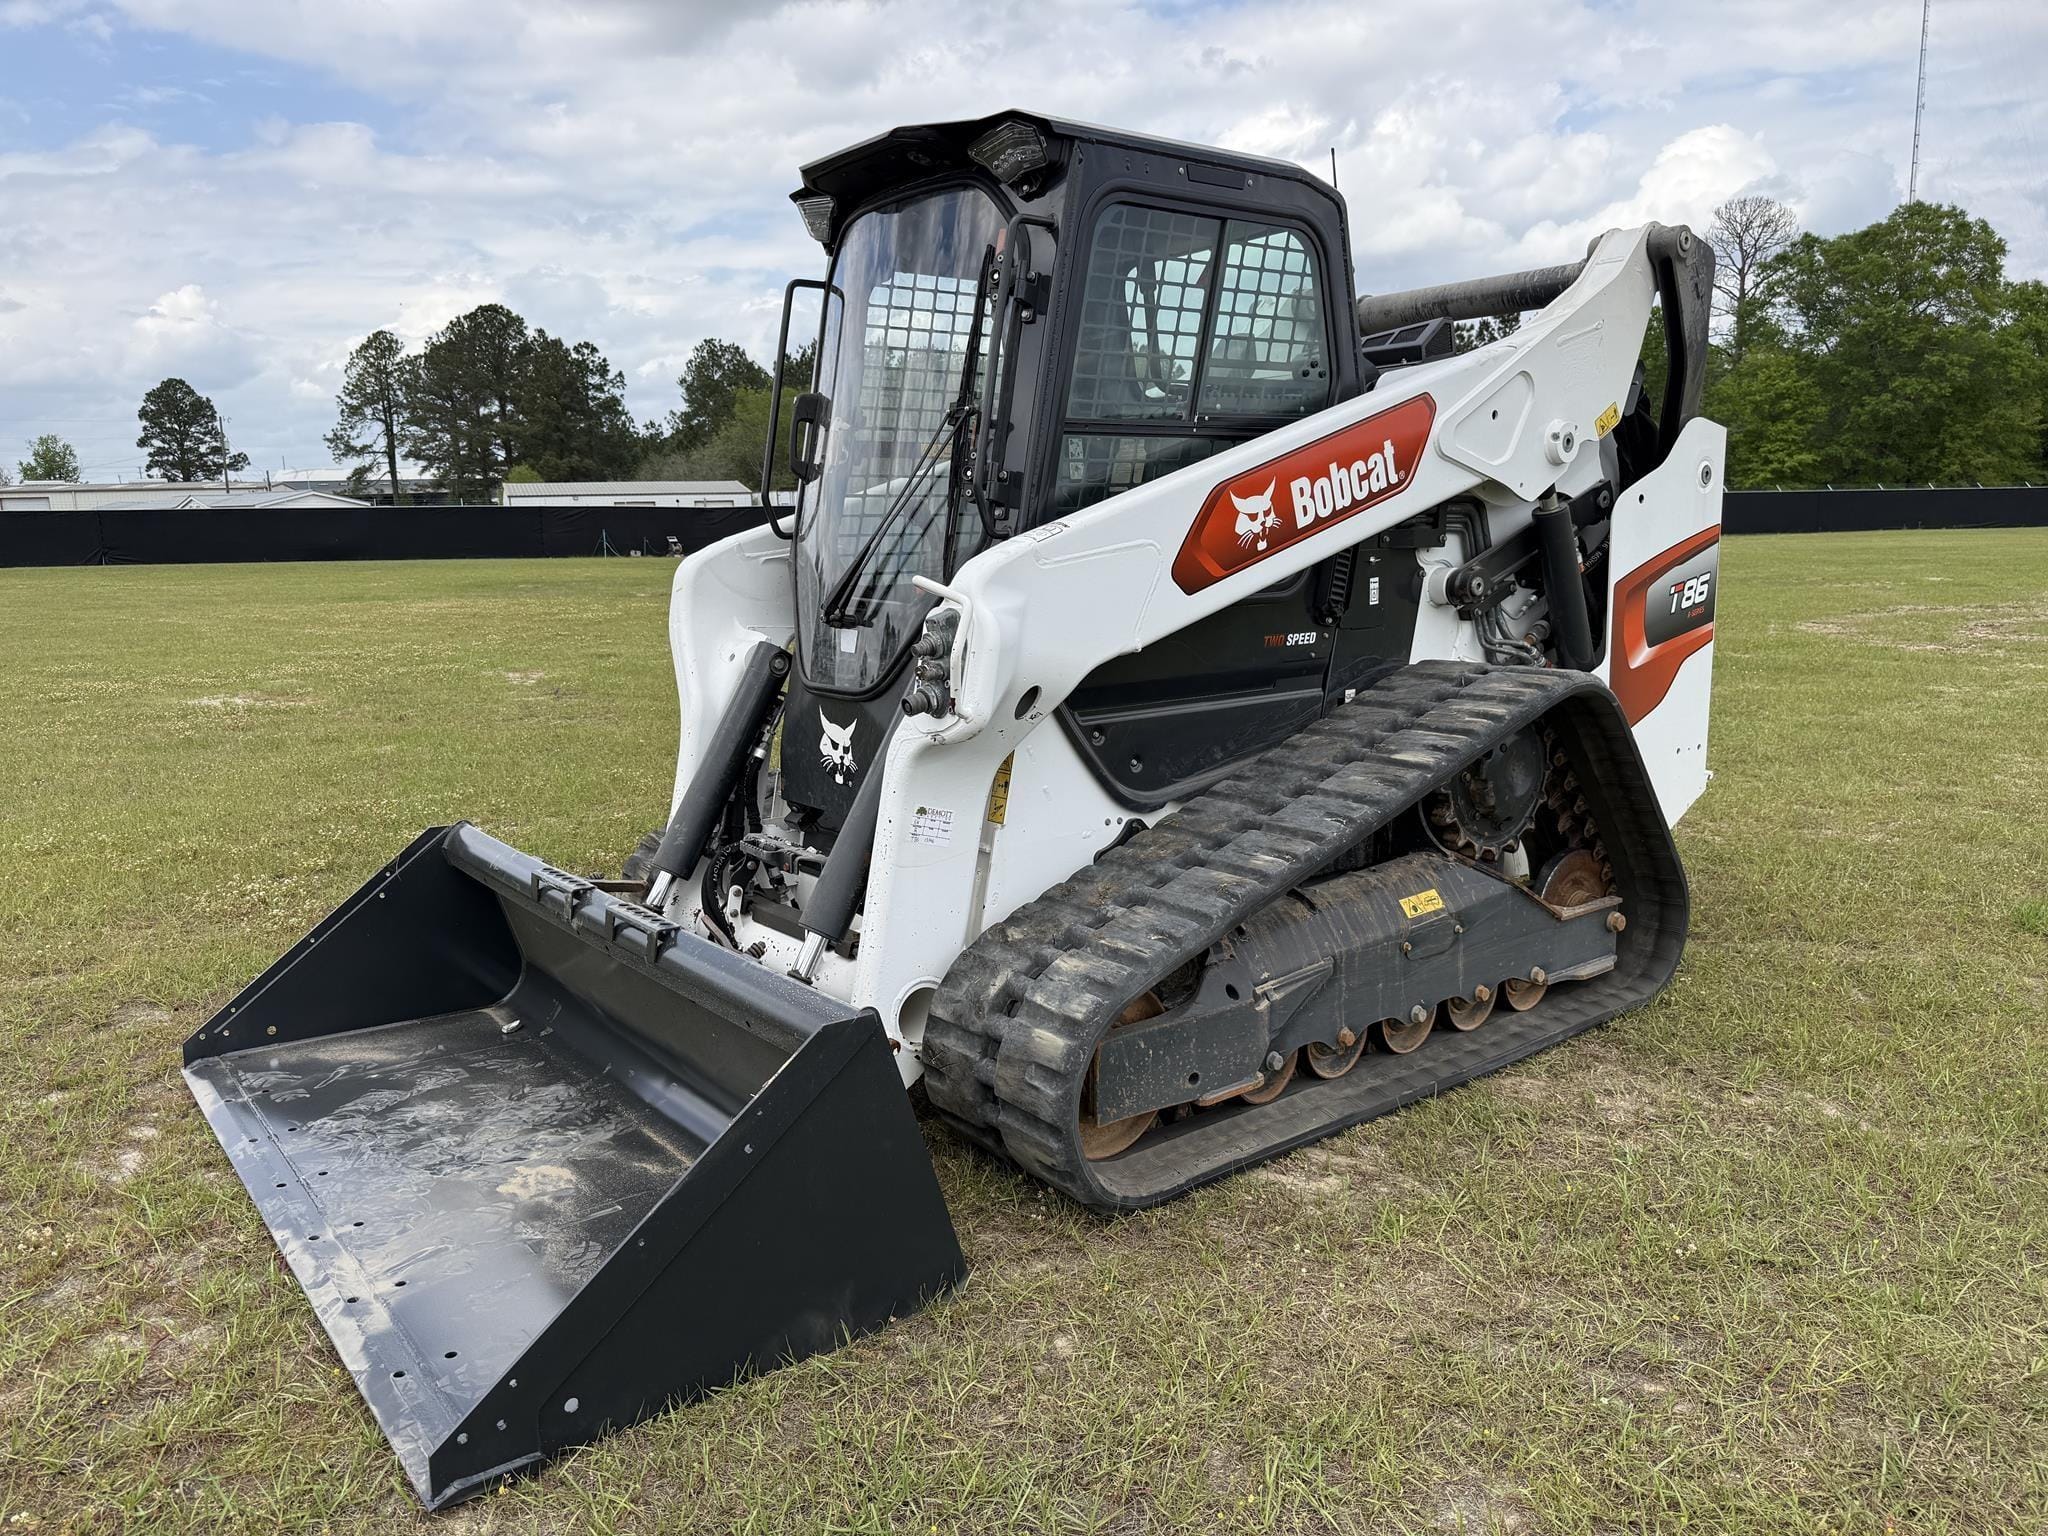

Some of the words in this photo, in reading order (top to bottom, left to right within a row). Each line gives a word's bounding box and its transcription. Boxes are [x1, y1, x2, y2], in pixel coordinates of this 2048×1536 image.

[1290, 439, 1399, 529] Bobcat
[1670, 571, 1711, 614] T86
[1264, 634, 1285, 647] TWO
[1286, 632, 1317, 646] SPEED
